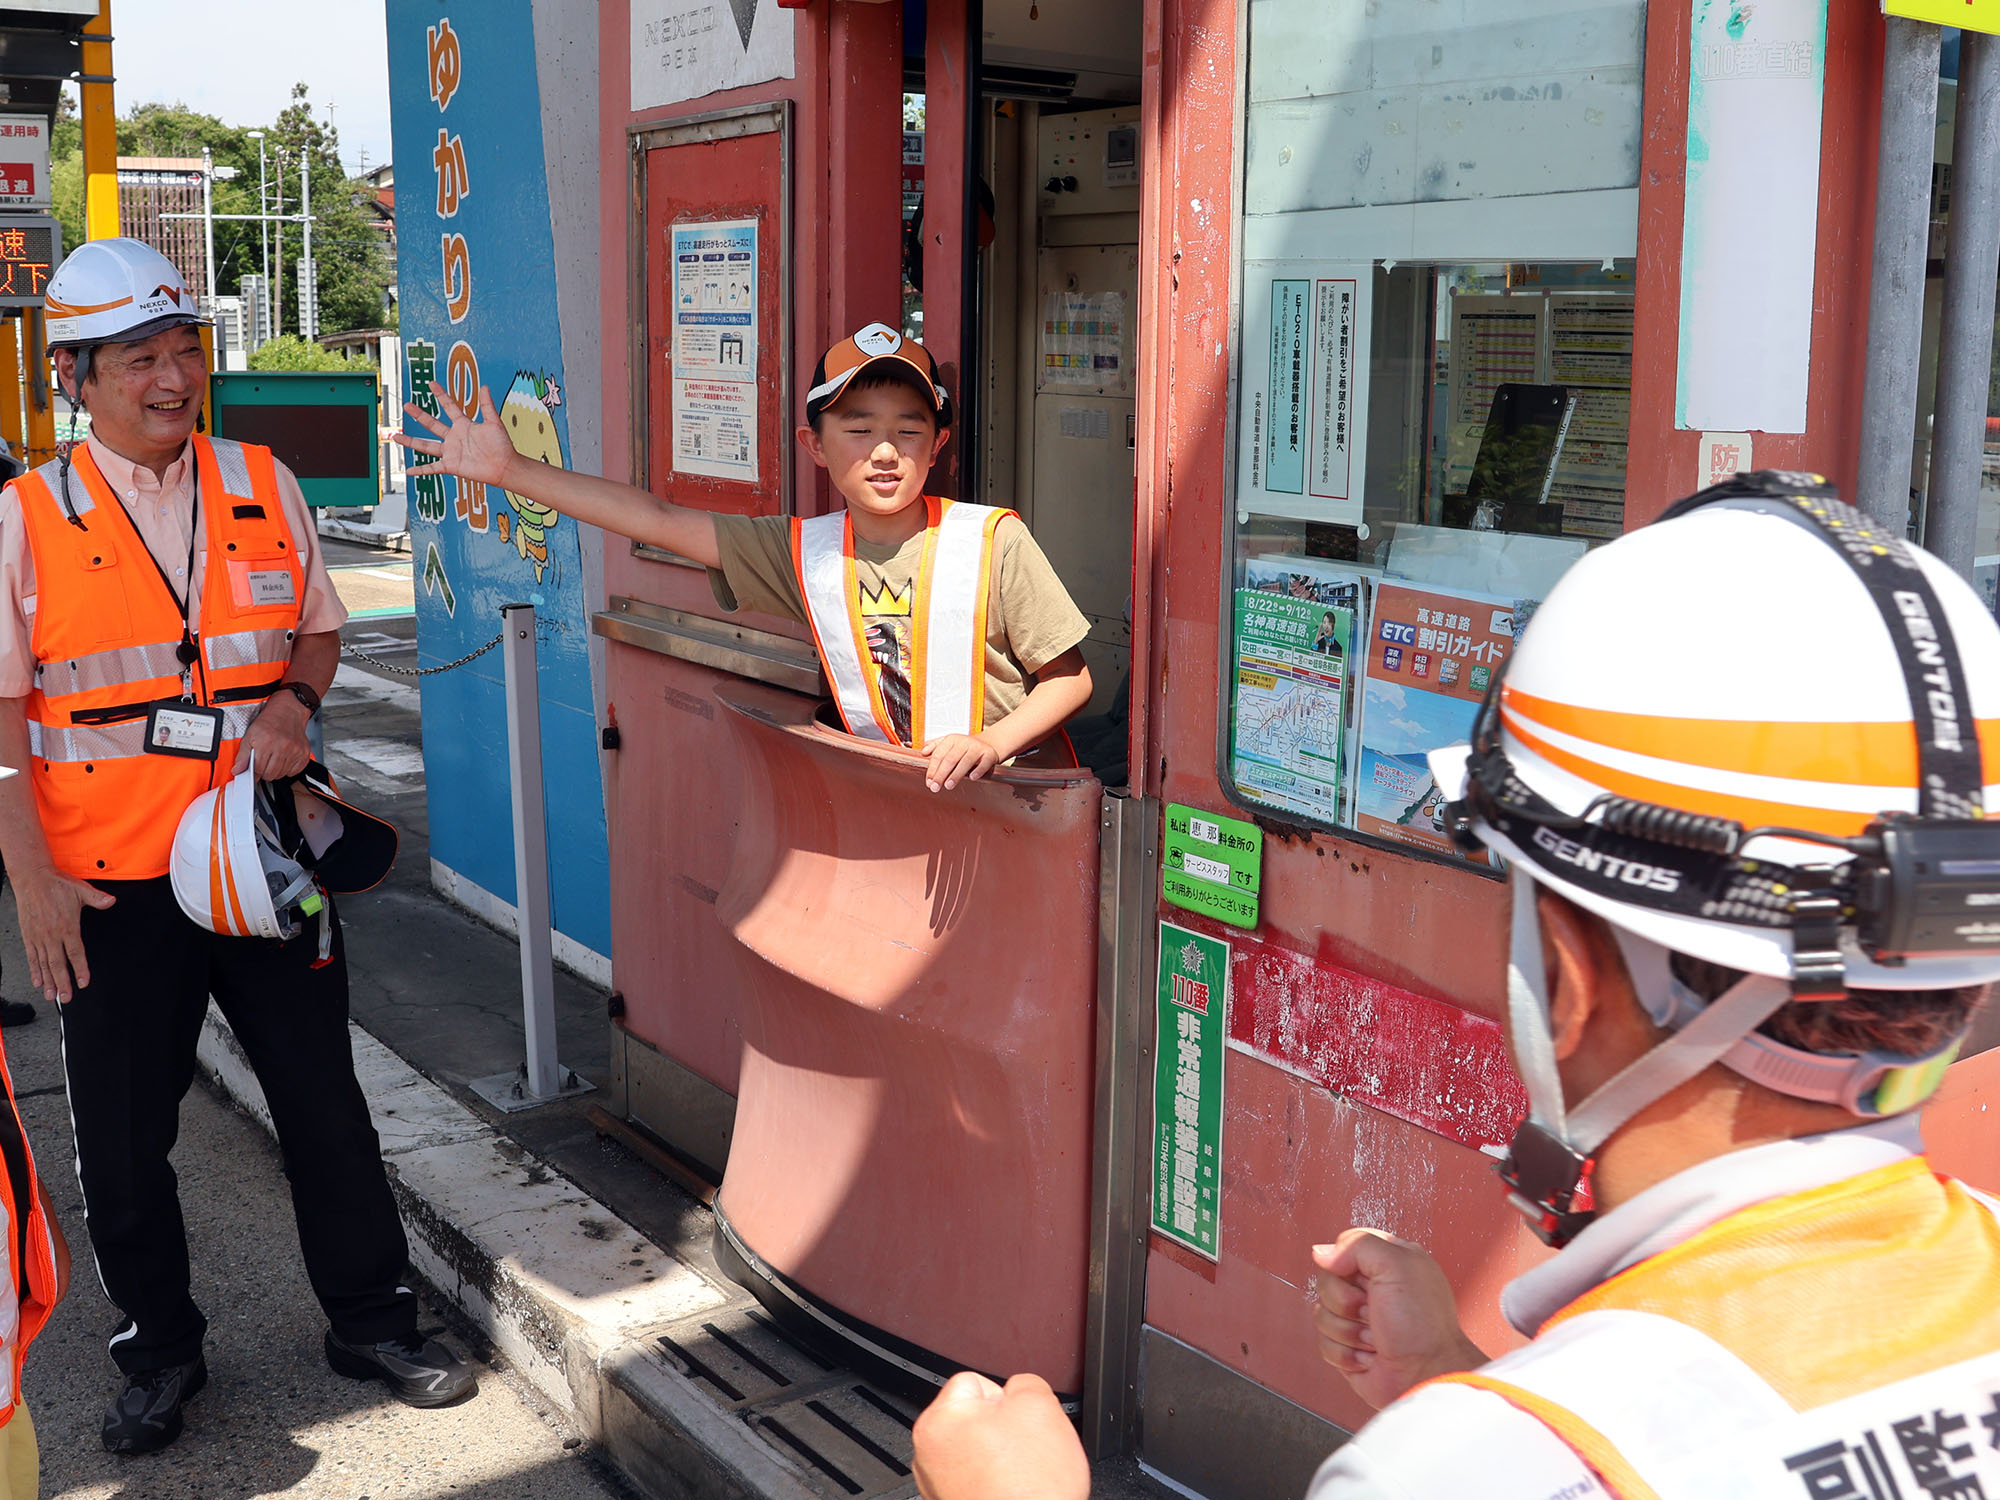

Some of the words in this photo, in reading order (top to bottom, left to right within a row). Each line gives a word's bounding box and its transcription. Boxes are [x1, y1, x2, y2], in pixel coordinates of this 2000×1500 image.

[645, 6, 713, 48] NEXCO
[661, 46, 697, 72] 中日本
[139, 299, 168, 311] NEXCO
[1336, 293, 1350, 453] 障がい者割引をご希望のお客様へ
[1417, 608, 1471, 632] 高速道路
[1382, 622, 1414, 643] ETC
[1417, 628, 1504, 664] 割引ガイド
[1415, 654, 1428, 664] 休日
[1185, 858, 1229, 880] サービススタッフ
[1235, 870, 1253, 886] です
[1532, 826, 1683, 893] GENTOS
[1164, 879, 1256, 919] ご利用ありがとうございます
[1171, 973, 1208, 1012] 110番
